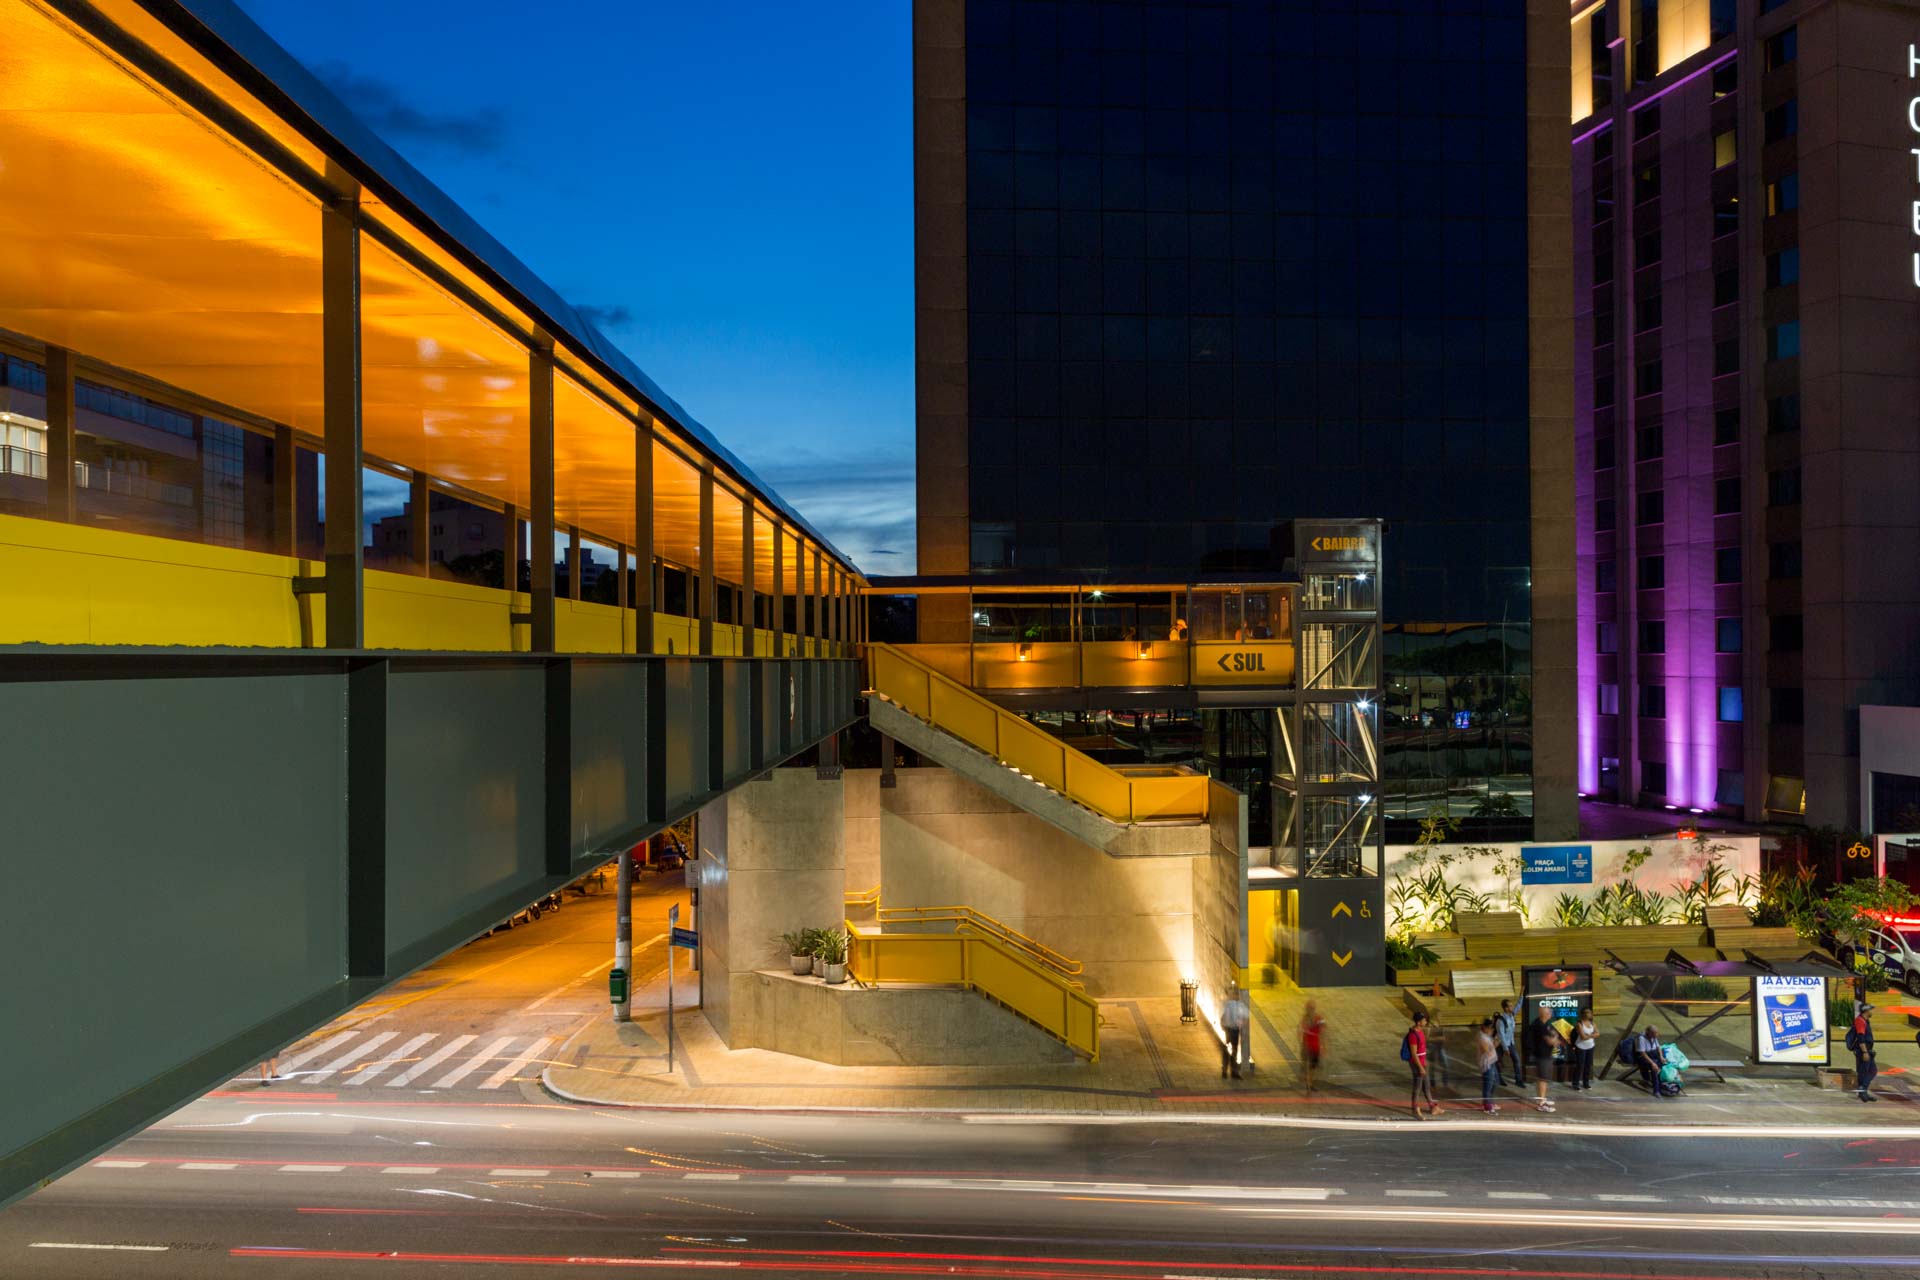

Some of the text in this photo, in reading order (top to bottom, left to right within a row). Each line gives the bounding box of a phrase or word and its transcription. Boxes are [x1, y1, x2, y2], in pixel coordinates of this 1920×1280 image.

[1323, 537, 1366, 550] BAIRRO
[1233, 653, 1265, 672] SUL
[1785, 975, 1821, 986] VENDA
